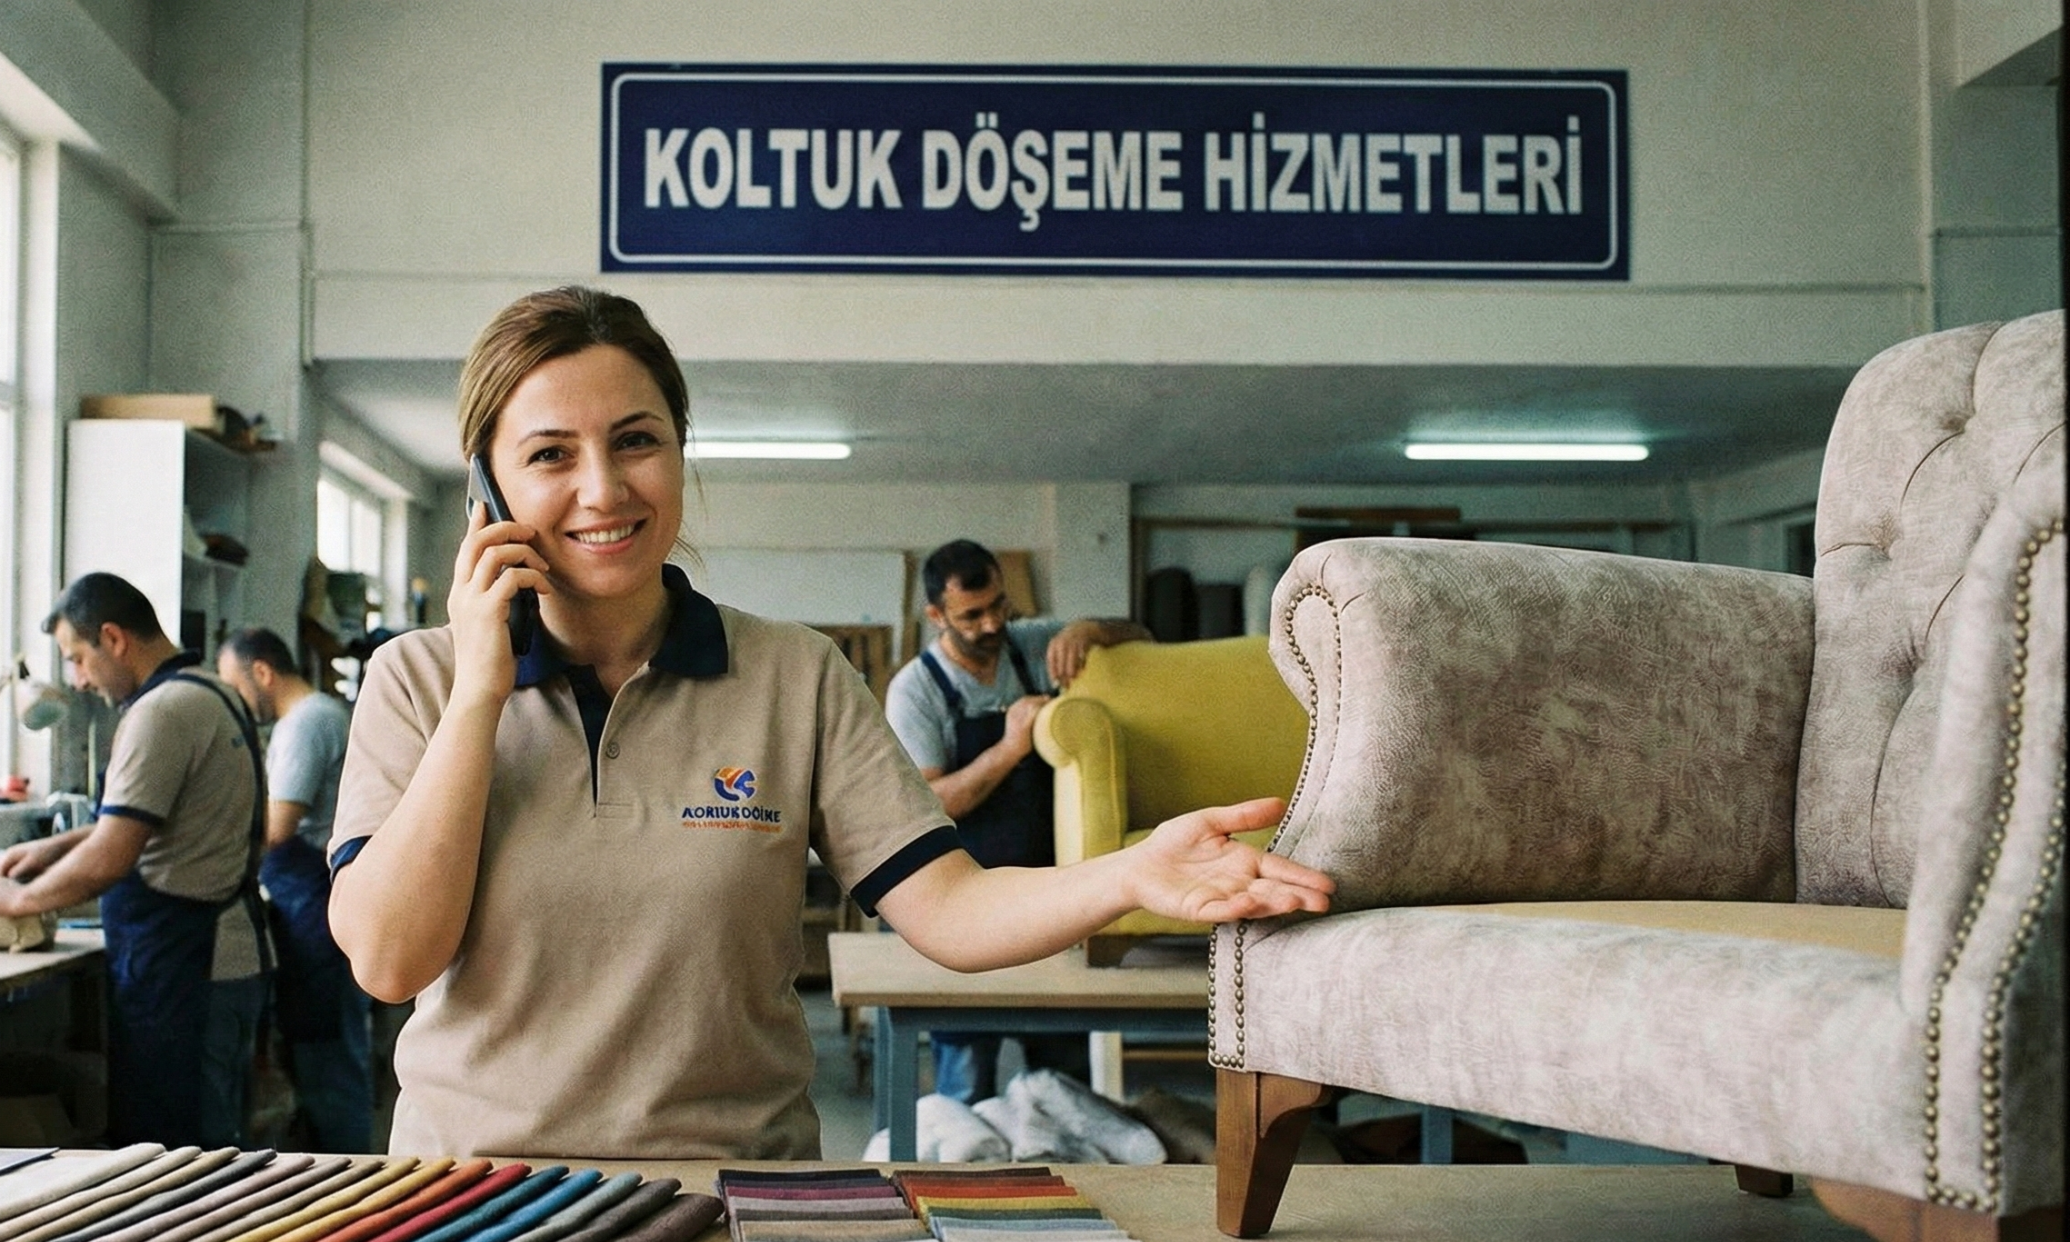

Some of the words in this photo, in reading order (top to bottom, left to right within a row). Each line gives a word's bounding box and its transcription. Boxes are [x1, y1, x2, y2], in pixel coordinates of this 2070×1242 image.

[644, 128, 901, 209] KOLTUK
[923, 113, 1182, 231] DÖŞEME
[1206, 113, 1580, 213] HİZMETLERİ
